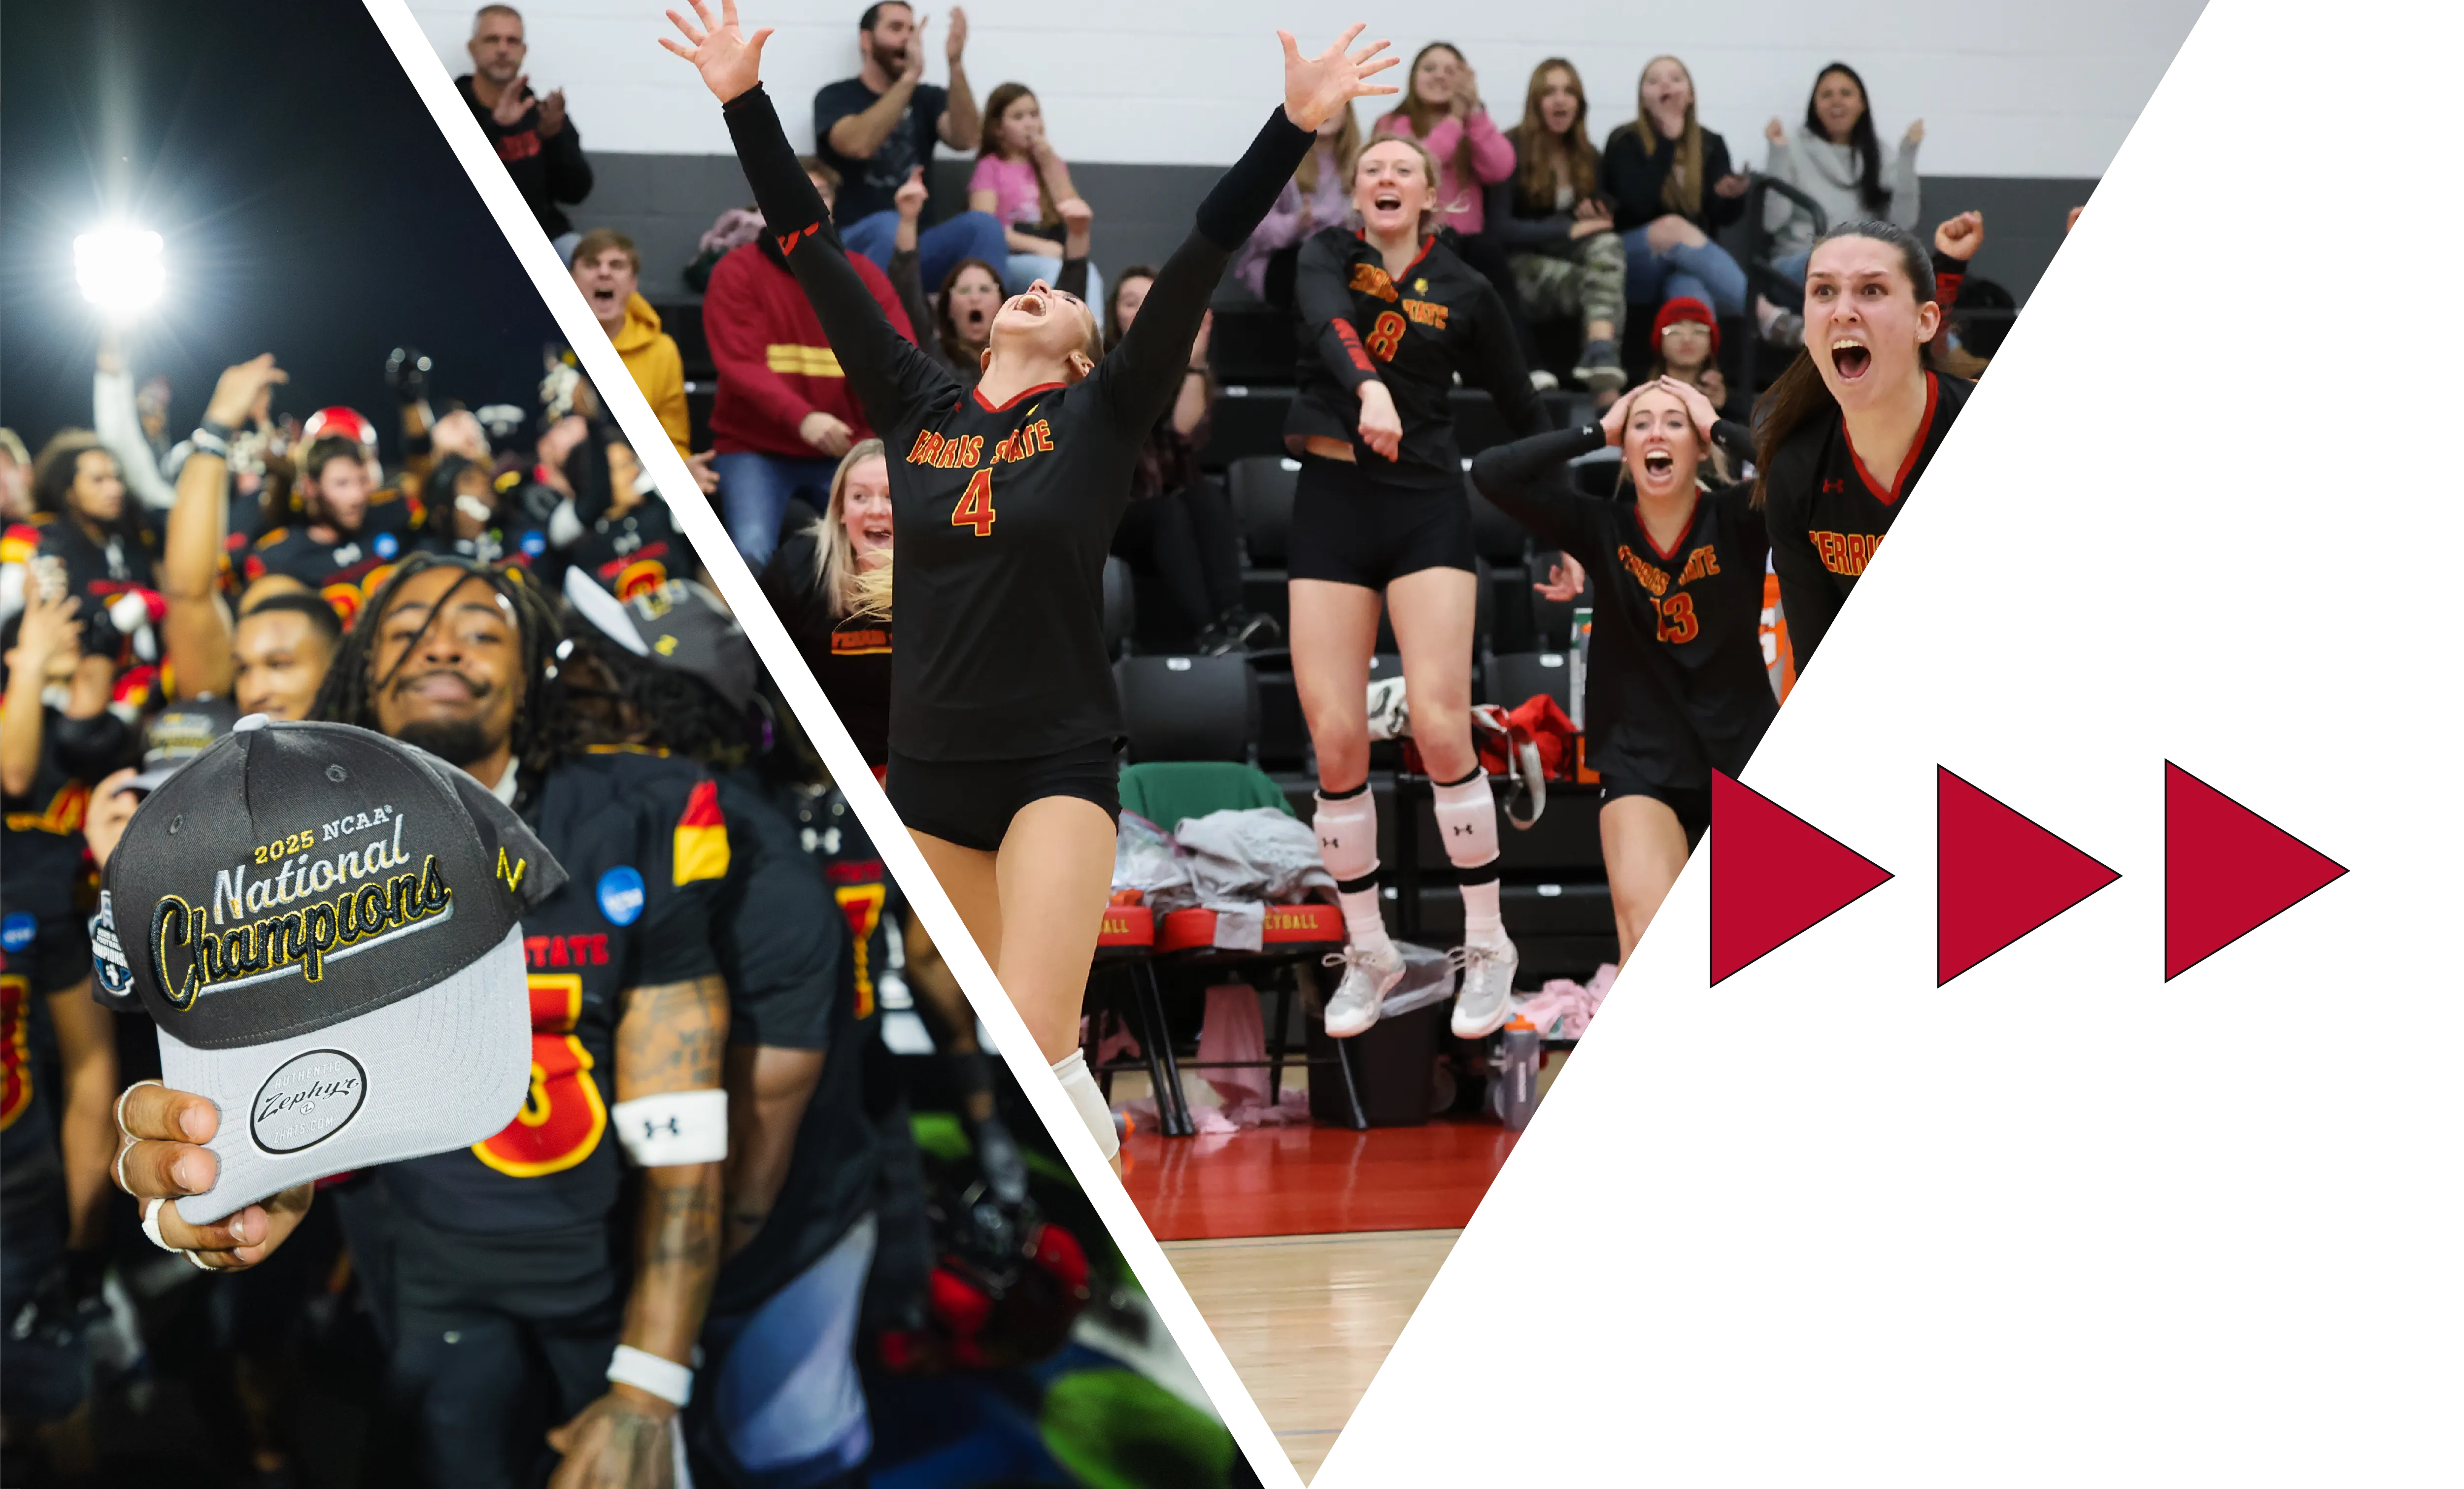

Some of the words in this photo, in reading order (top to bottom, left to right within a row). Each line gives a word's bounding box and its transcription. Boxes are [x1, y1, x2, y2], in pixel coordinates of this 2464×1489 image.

[1366, 310, 1406, 363] 8
[952, 467, 995, 537] 4
[1809, 531, 1886, 575] ERRI
[1650, 592, 1699, 644] 13
[214, 814, 410, 924] National
[254, 829, 315, 865] 2025
[149, 854, 451, 1012] Champions
[524, 933, 609, 967] TATE
[274, 1061, 341, 1089] AUTHENTIC
[257, 1079, 359, 1123] Zephyr
[274, 1117, 334, 1143] ZHATS.COM
